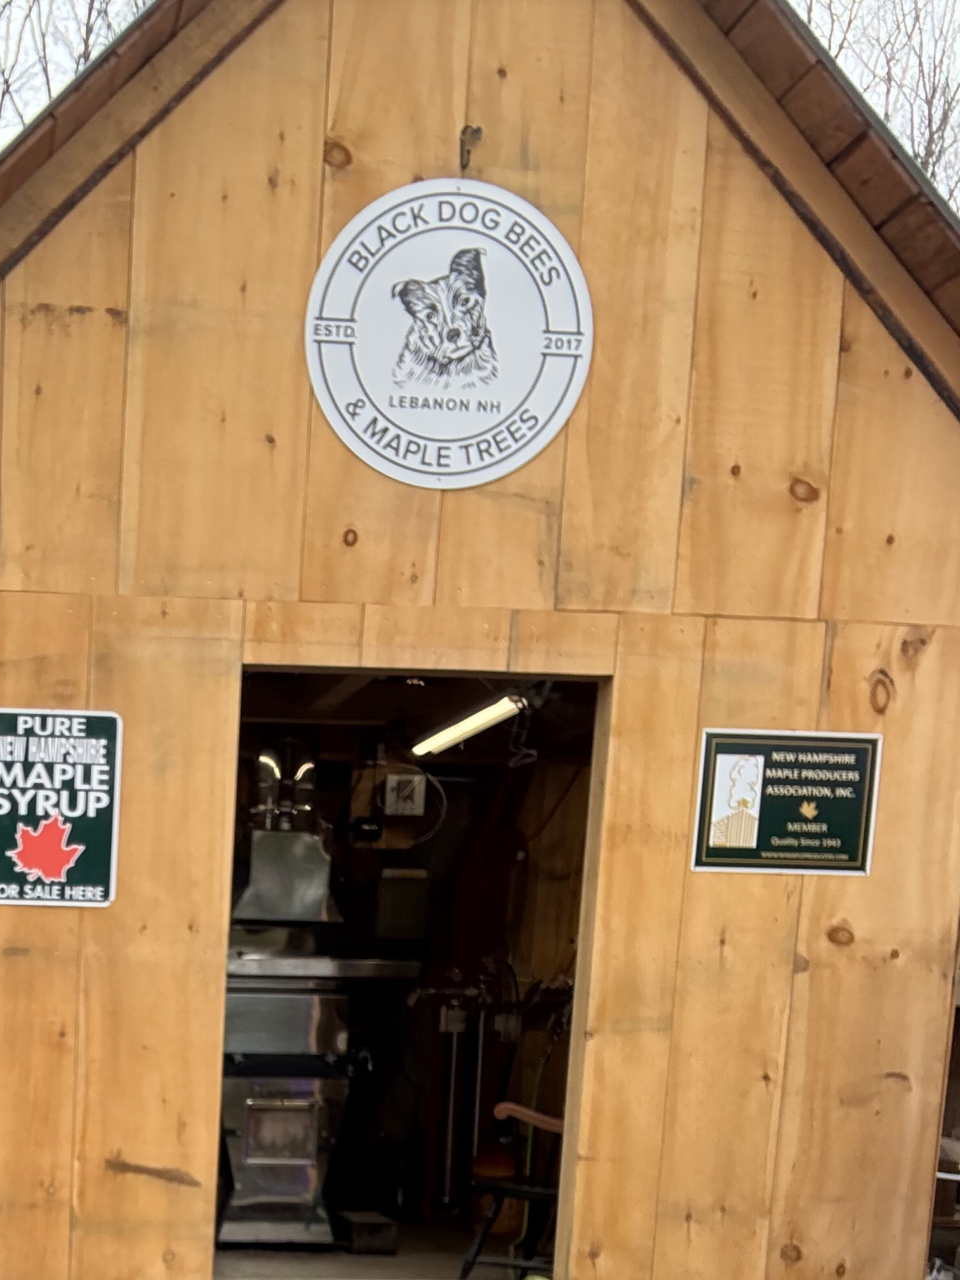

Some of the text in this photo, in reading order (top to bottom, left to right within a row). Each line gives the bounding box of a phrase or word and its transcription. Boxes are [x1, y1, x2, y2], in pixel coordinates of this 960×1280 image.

[347, 201, 560, 286] BLACK DOG BEES
[543, 337, 582, 351] 2017
[389, 395, 501, 413] LEBANON NH
[345, 398, 539, 468] & MAPLE TREES
[17, 715, 87, 736] PURE
[771, 751, 856, 765] NEW HAMPSHIRE
[765, 768, 860, 782] MAPLE PRODUCERS
[765, 785, 856, 799] ASSOCIATION, INC.
[787, 822, 828, 833] MEMBER
[770, 836, 798, 848] Quality
[23, 884, 61, 900] SALE
[64, 886, 105, 901] HERE
